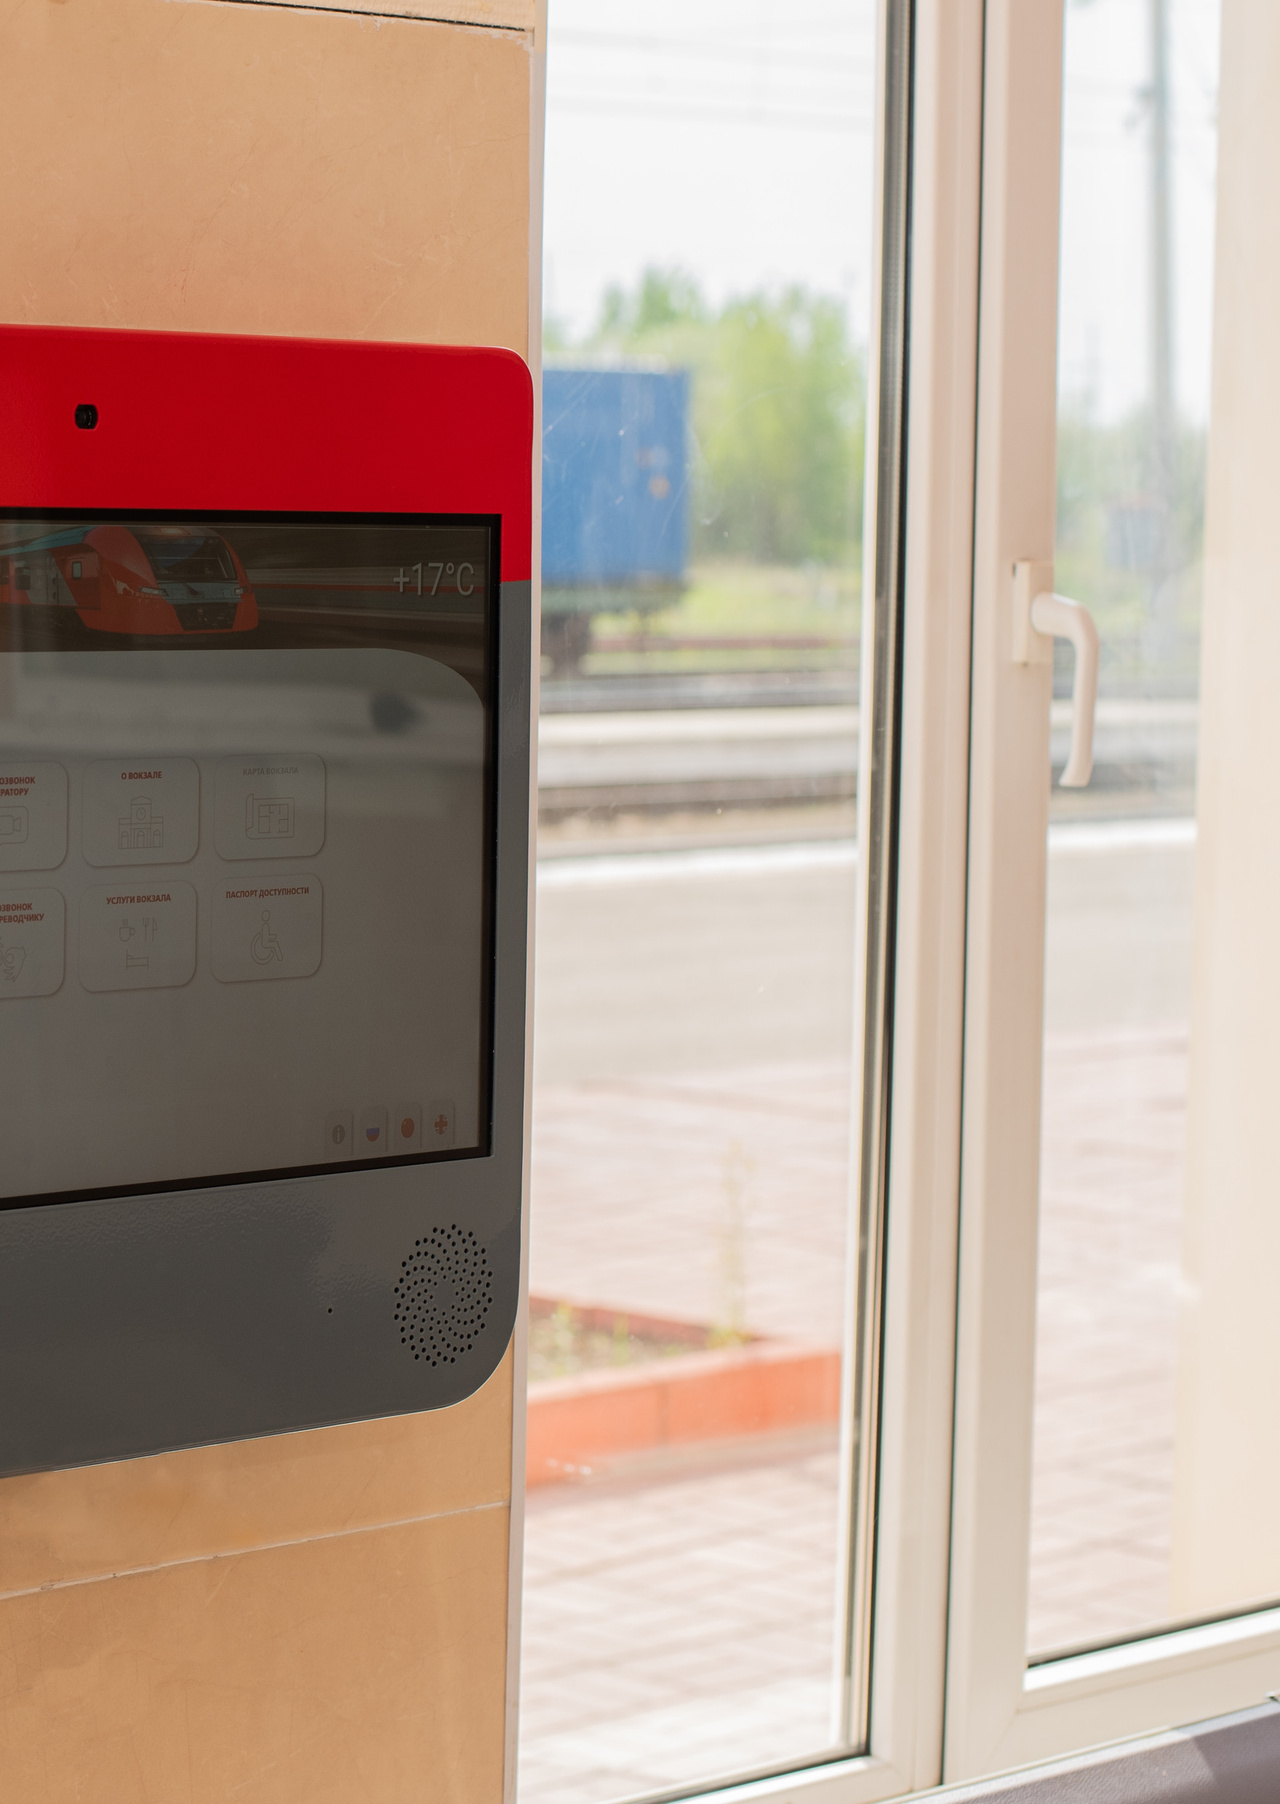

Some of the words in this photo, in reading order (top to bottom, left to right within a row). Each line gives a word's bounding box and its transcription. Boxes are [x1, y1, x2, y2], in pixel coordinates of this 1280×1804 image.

[393, 562, 474, 596] +17°C
[128, 770, 163, 780] ВОКЗАЛЕ
[242, 767, 265, 777] КАРТА
[266, 766, 299, 776] ВОКЗАЛА
[106, 895, 135, 905] УСЛУГИ
[136, 893, 172, 904] ВОКЗАЛА
[226, 889, 258, 899] ПАСПОРТ
[258, 887, 310, 899] ДОСТУПНОСТИ
